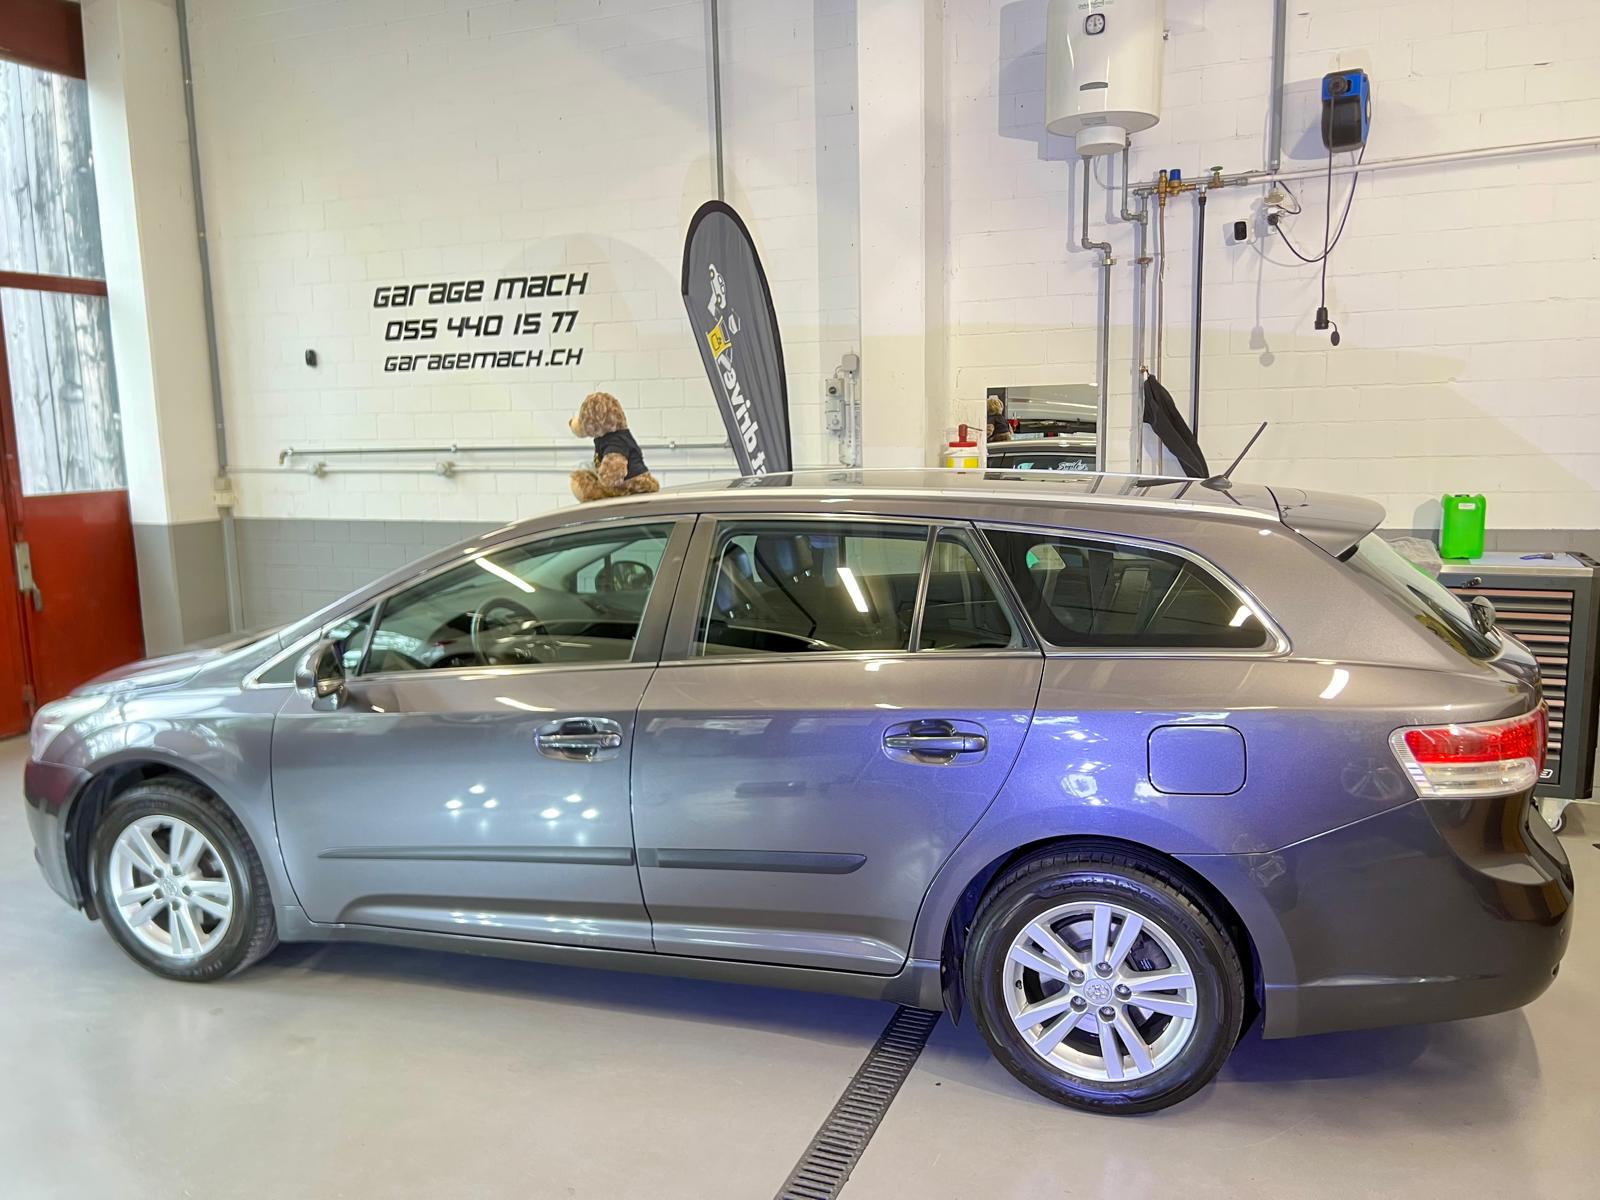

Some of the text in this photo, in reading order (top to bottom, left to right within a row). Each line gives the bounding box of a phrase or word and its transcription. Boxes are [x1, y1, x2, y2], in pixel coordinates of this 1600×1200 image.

[385, 310, 579, 341] 055 440 15 77
